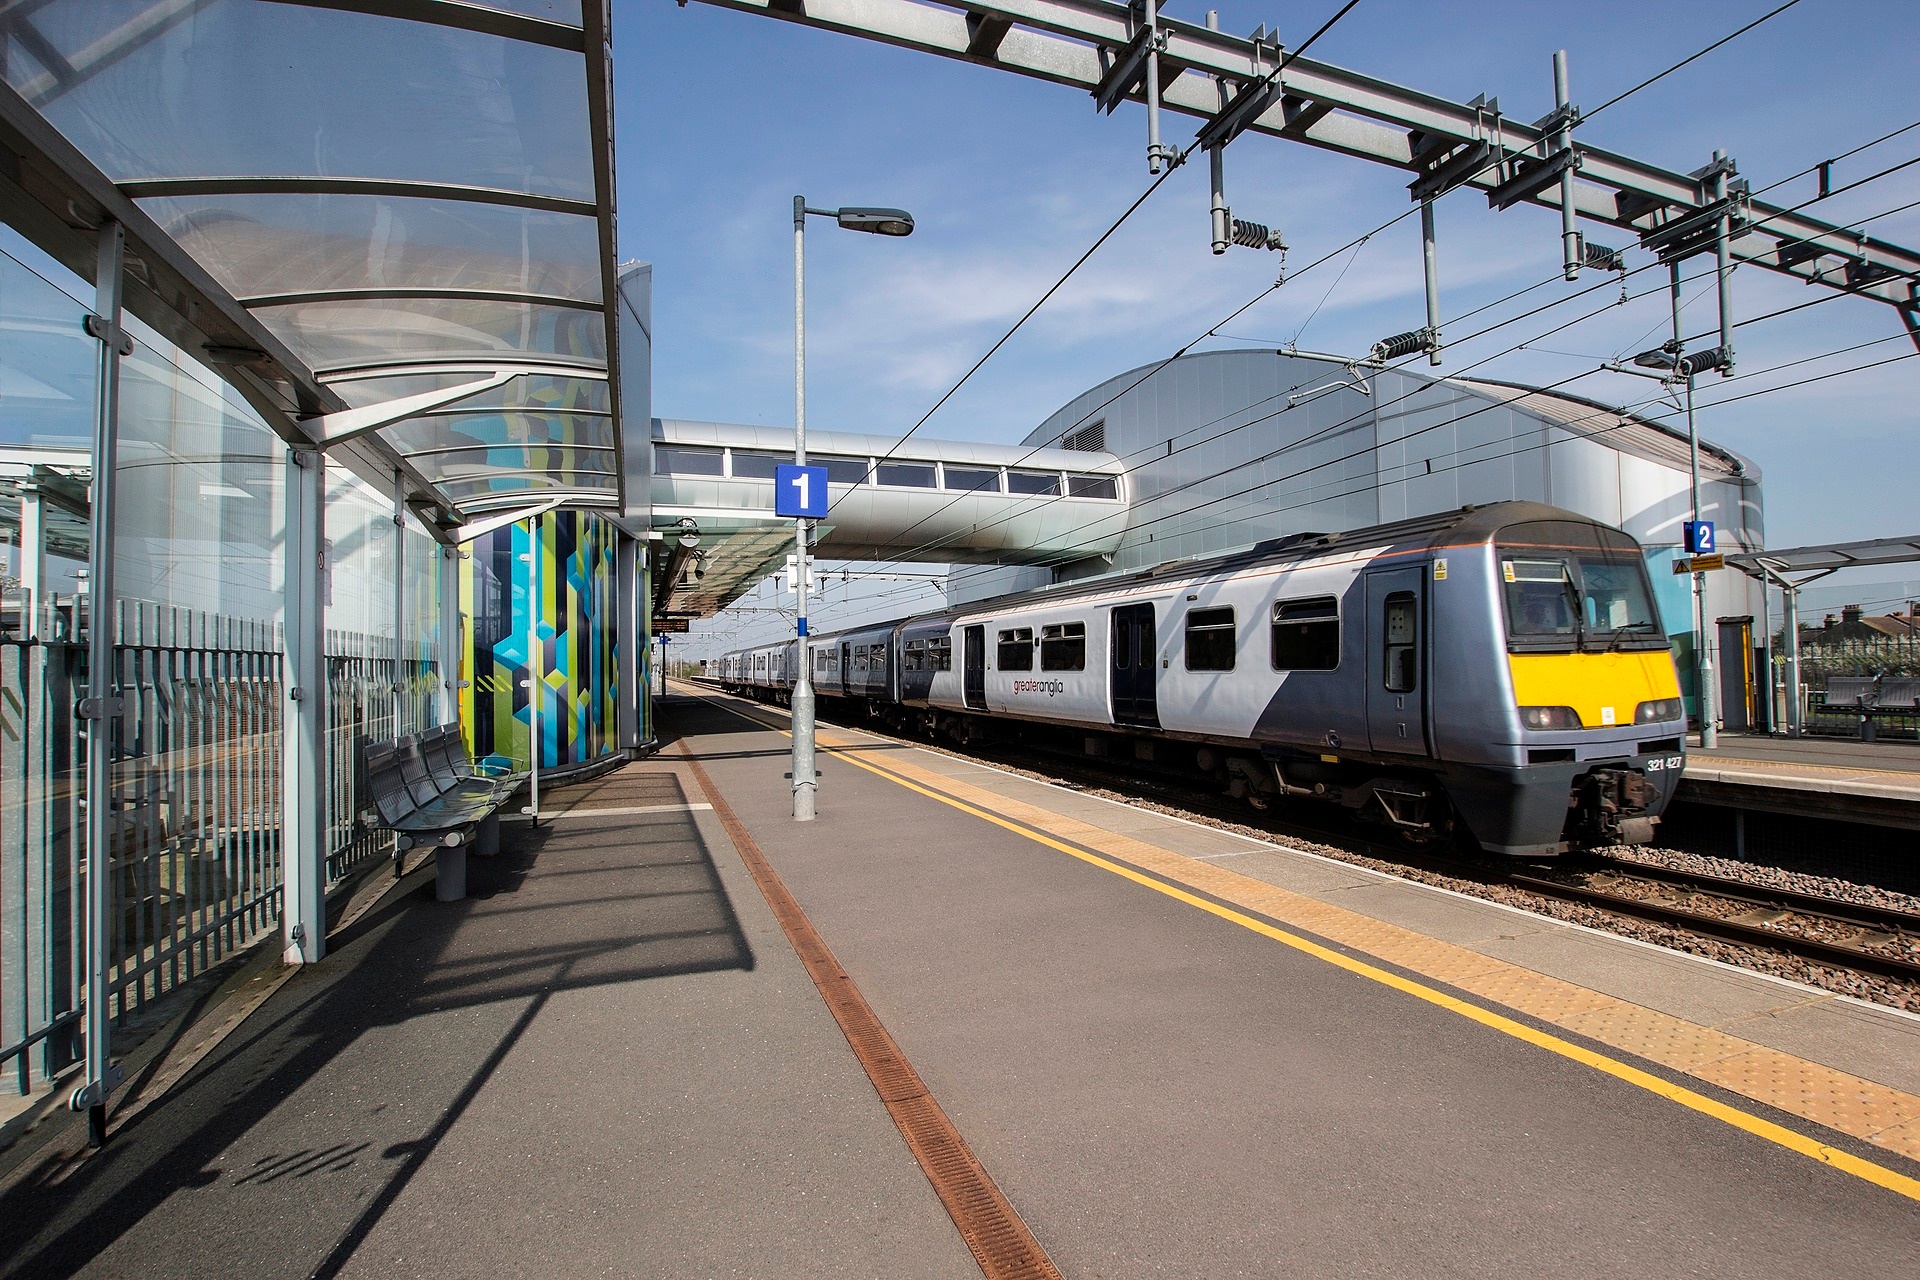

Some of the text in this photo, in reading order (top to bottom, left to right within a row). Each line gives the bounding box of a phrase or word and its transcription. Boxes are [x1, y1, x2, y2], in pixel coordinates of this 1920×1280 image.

[792, 473, 809, 509] 1
[1699, 525, 1711, 549] 2
[1013, 678, 1064, 698] greateranglia
[1647, 756, 1682, 772] 321 427
